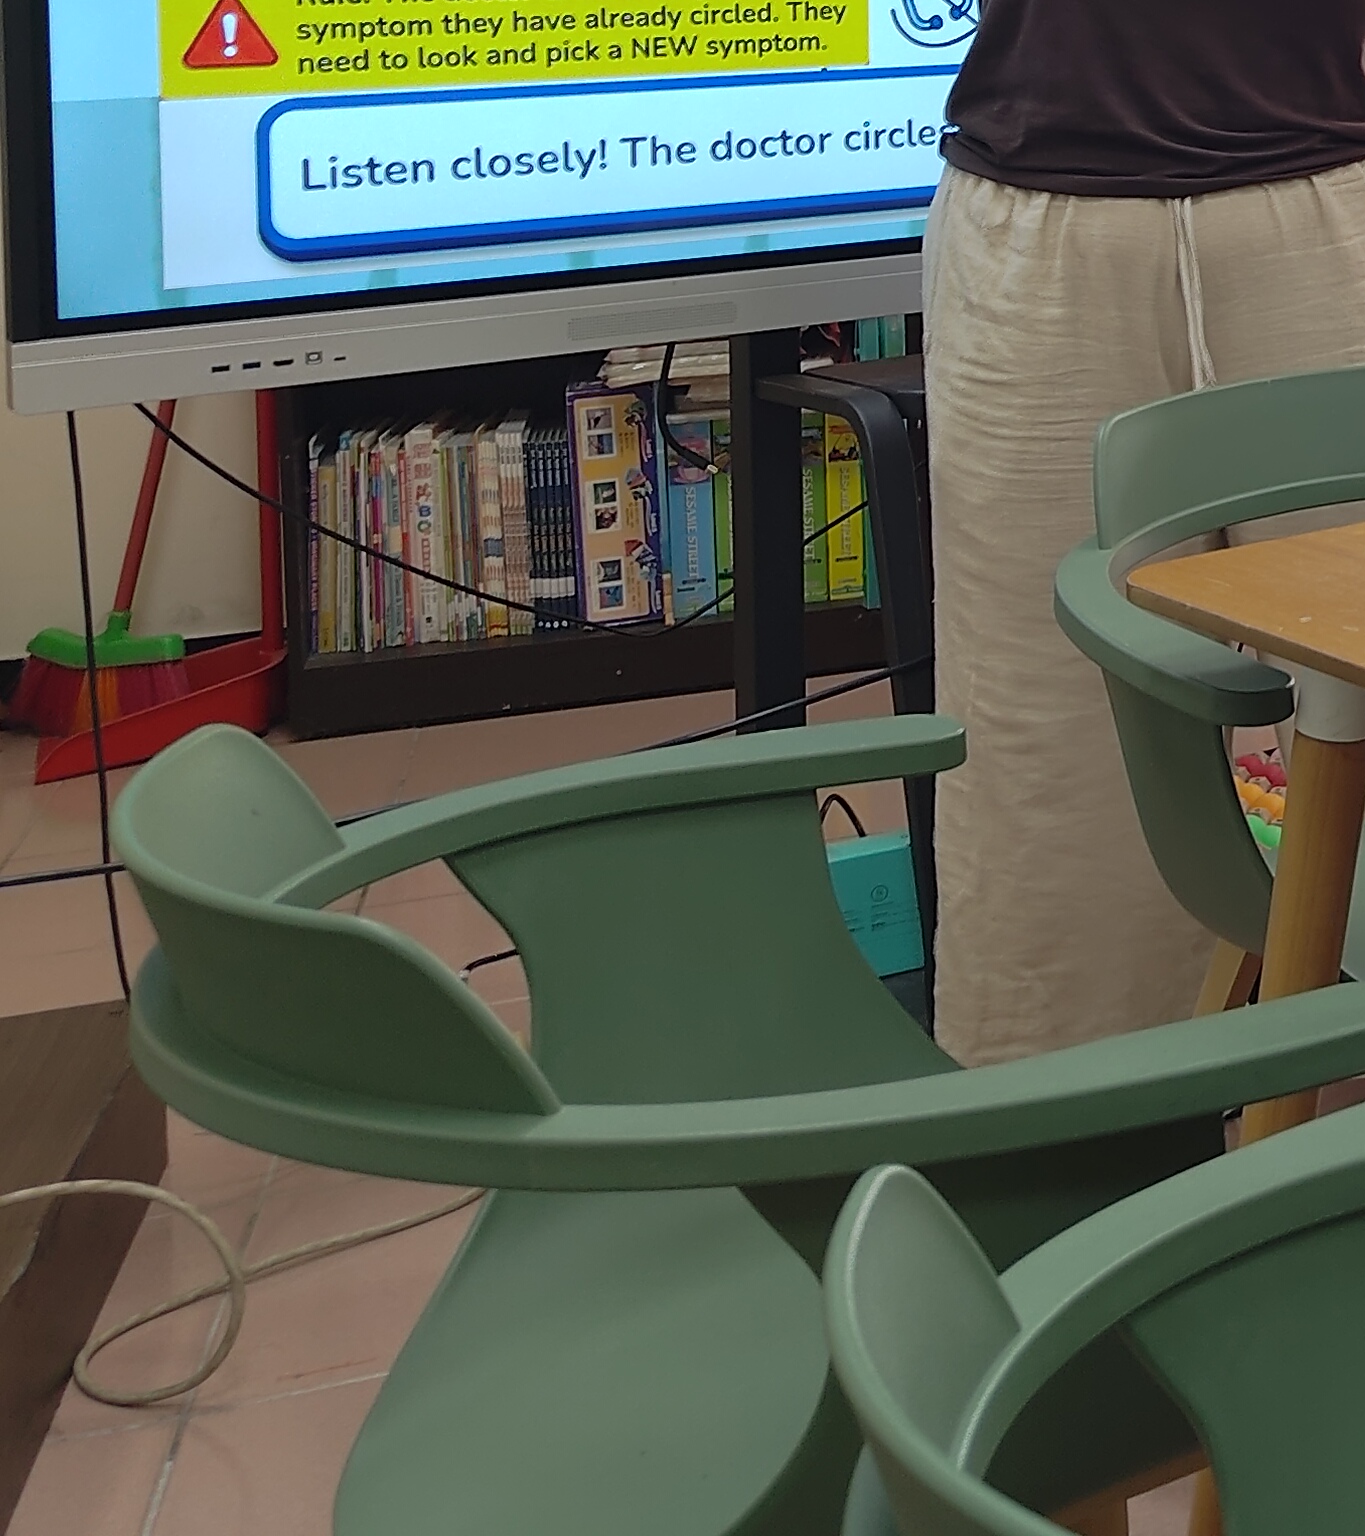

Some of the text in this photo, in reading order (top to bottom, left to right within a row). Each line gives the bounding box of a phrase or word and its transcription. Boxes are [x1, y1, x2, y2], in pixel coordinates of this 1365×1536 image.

[295, 0, 848, 48] symptom they have already circled. They
[297, 30, 829, 75] need to look and pick a NEW symptom.
[300, 119, 948, 192] Listen closely! The doctor circle
